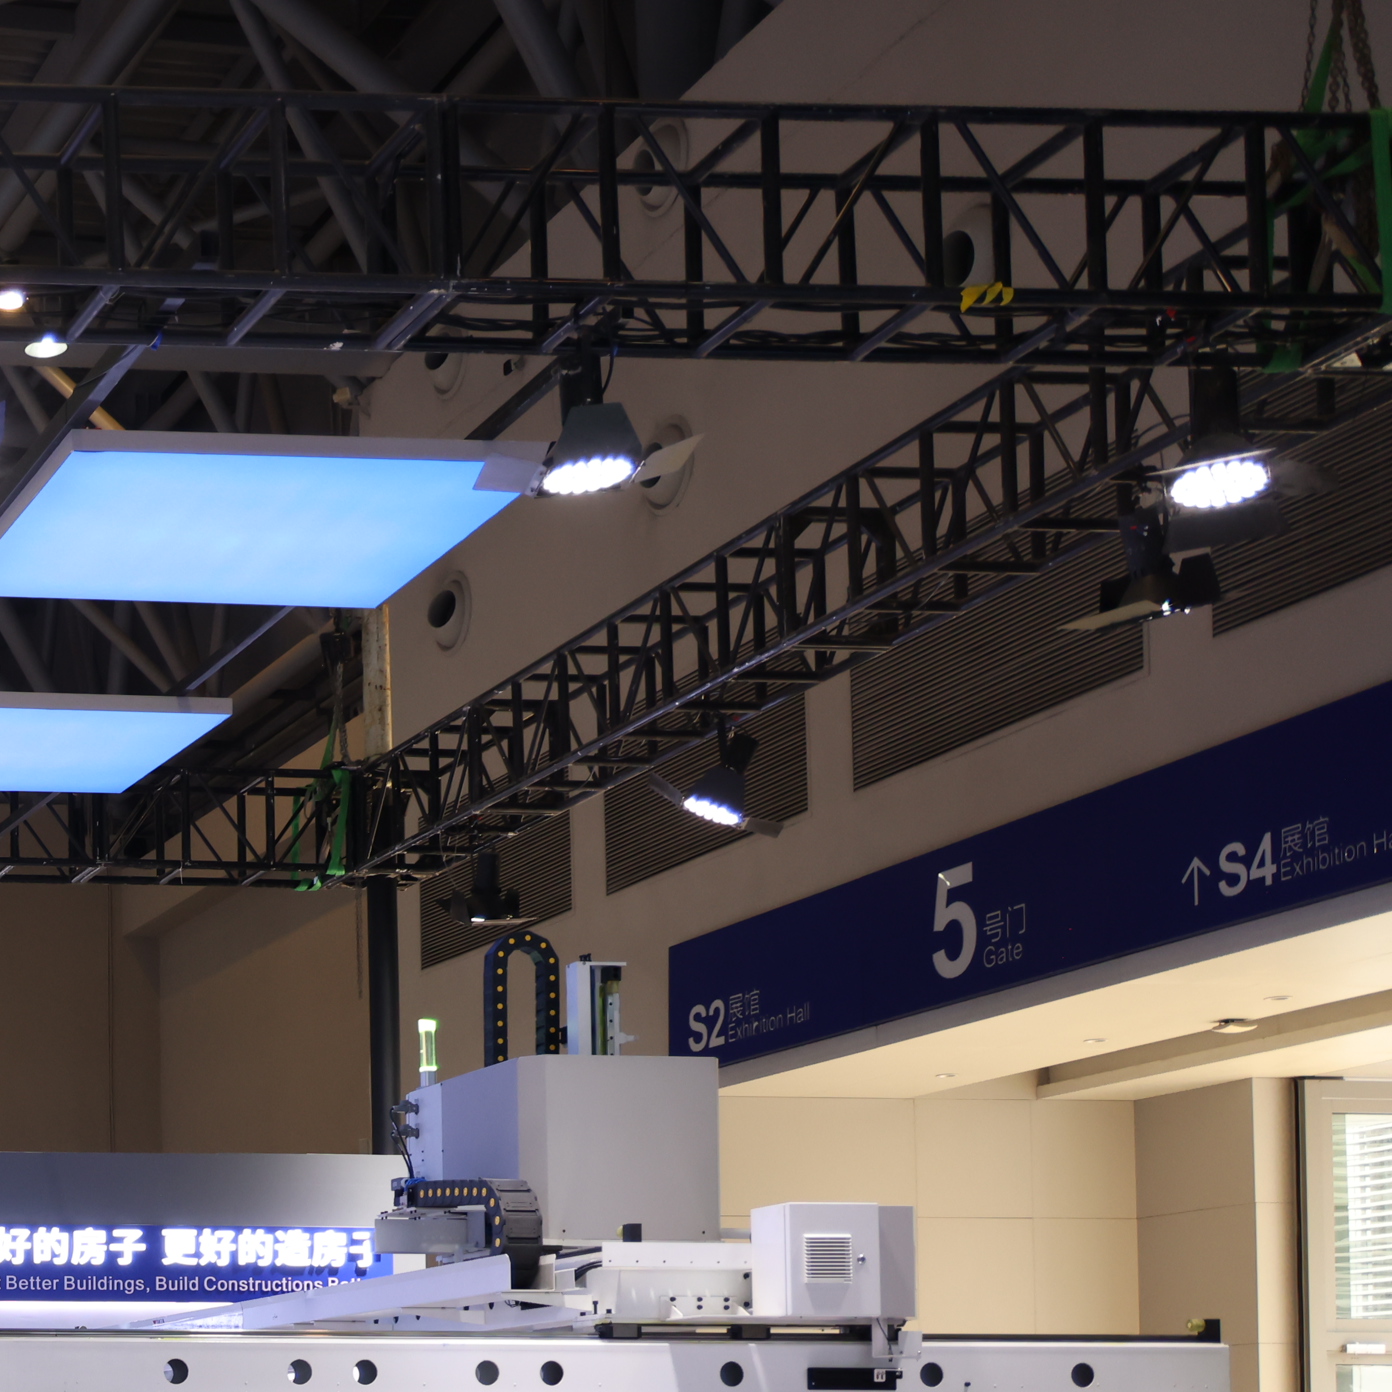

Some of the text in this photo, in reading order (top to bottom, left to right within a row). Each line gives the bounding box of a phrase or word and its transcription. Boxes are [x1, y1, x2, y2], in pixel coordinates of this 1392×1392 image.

[1218, 816, 1330, 897] S4 展馆
[1280, 842, 1366, 881] Exhibition
[932, 861, 1026, 979] 5 号门
[983, 943, 1023, 968] Gate
[688, 990, 760, 1052] S2 展馆
[728, 1001, 810, 1042] Exhibition Hall
[6, 1275, 59, 1290] Better
[64, 1276, 151, 1294] Buildings,
[155, 1276, 199, 1291] Build
[204, 1276, 323, 1292] Constructions
